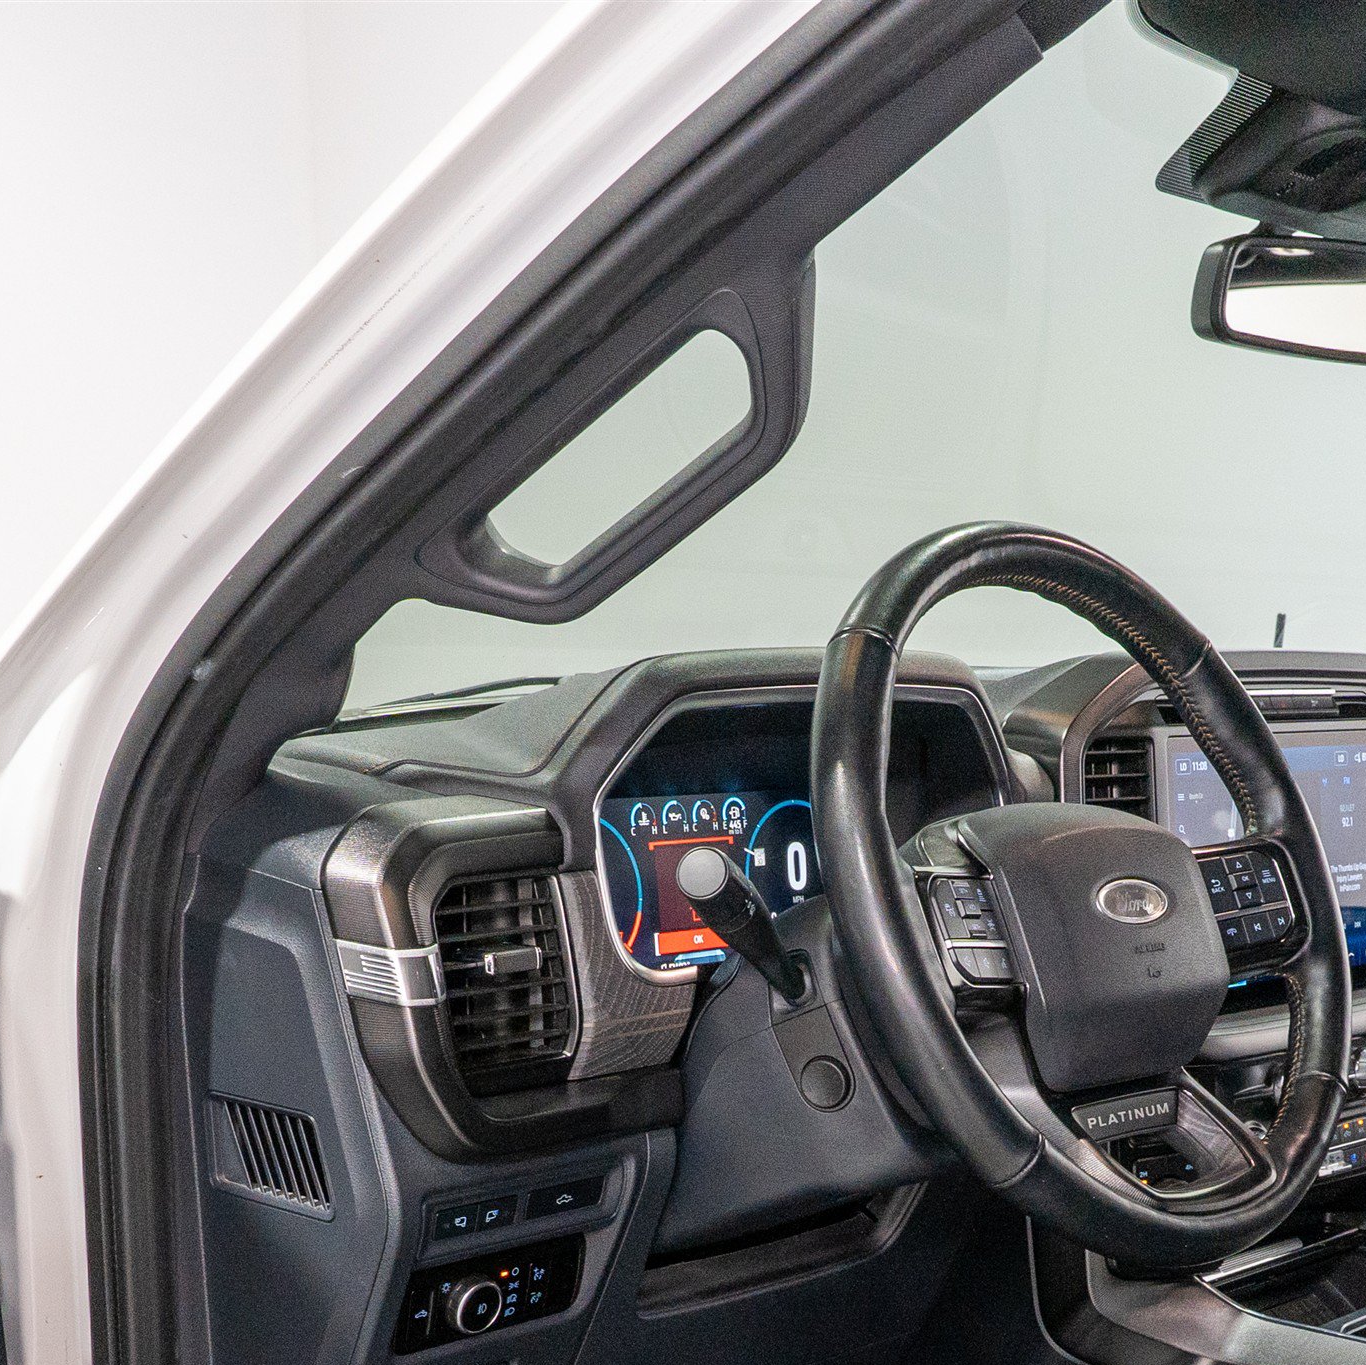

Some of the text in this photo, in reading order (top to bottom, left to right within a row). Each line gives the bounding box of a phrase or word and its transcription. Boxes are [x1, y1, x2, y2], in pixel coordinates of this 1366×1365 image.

[692, 822, 719, 832] C H
[723, 821, 728, 830] E
[743, 820, 748, 829] F
[1341, 816, 1353, 828] 92.1
[631, 826, 658, 836] C H
[662, 824, 689, 834] L H
[787, 841, 807, 891] 0
[1211, 886, 1225, 894] BACK
[693, 935, 704, 944] OK
[1087, 1102, 1170, 1129] PLATINUM
